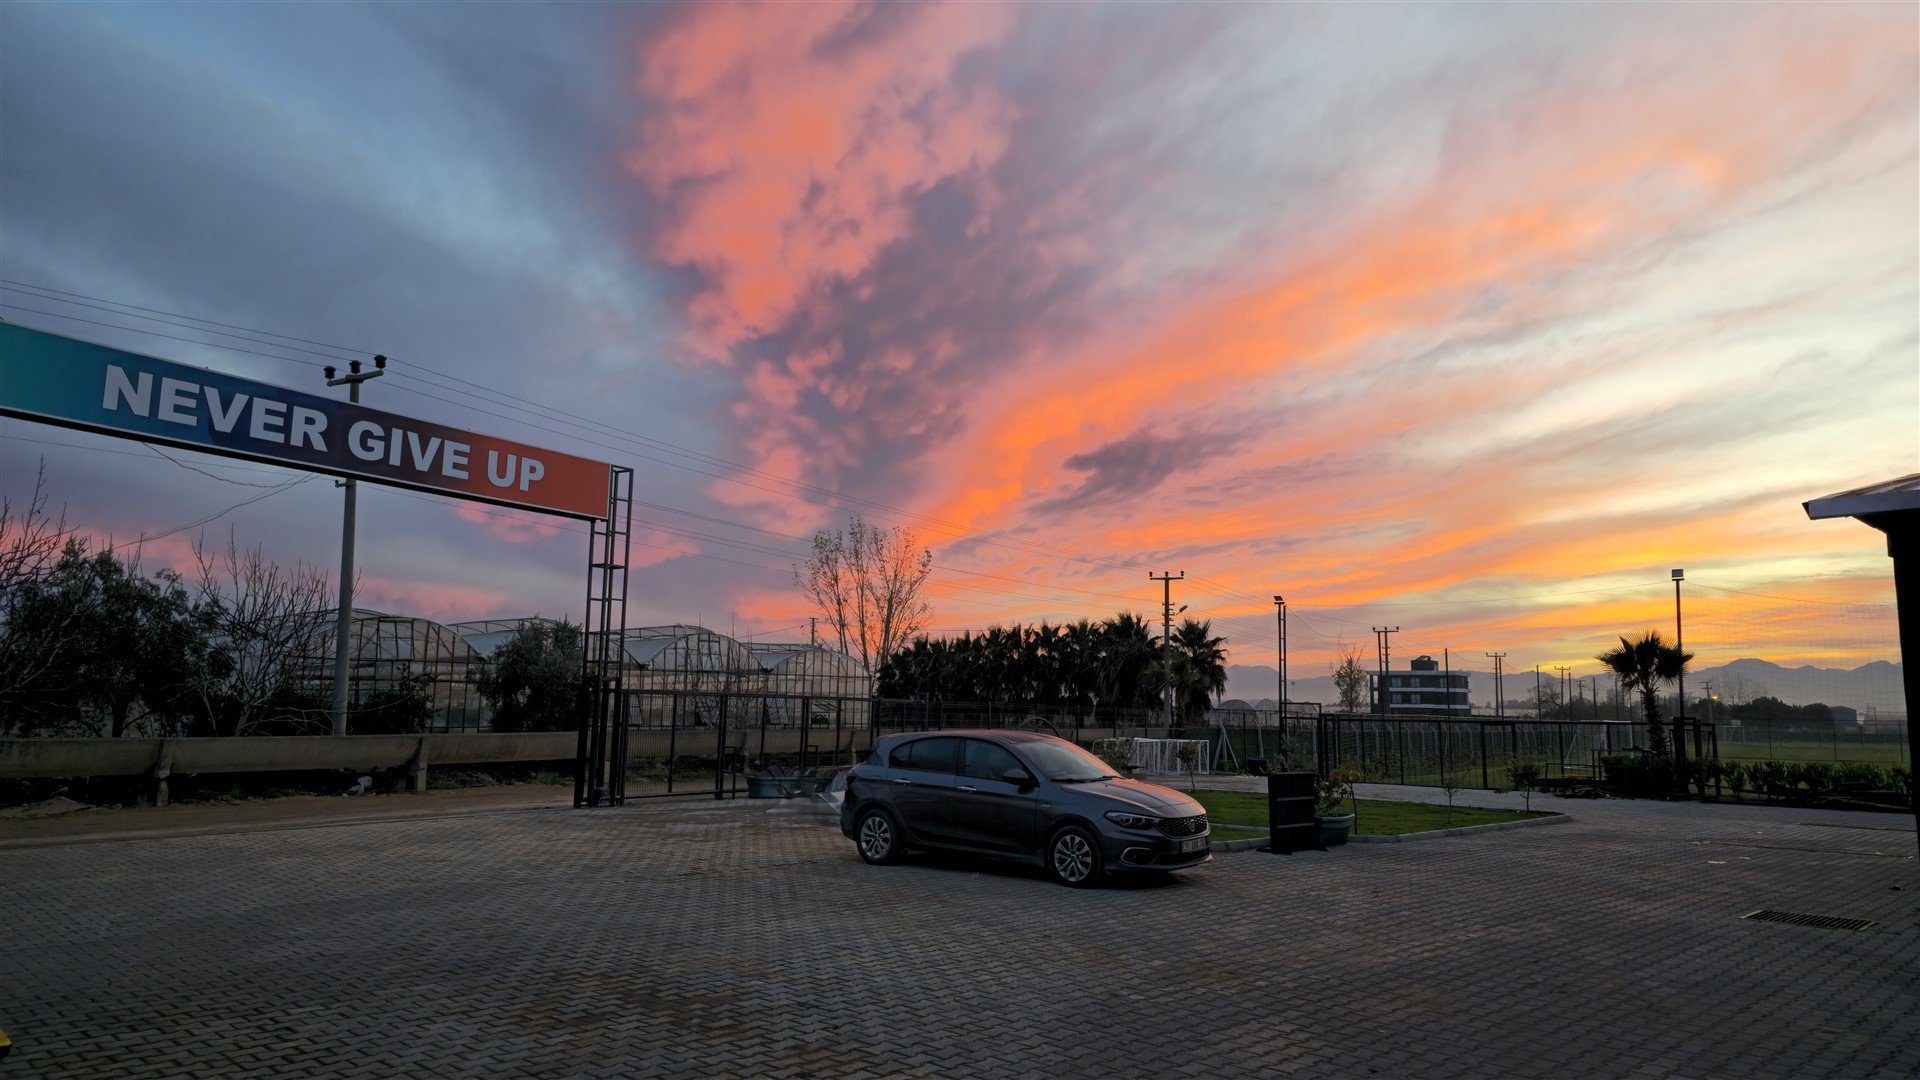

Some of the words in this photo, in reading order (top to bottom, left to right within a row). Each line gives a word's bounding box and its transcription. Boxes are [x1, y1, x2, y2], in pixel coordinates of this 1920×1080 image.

[103, 365, 328, 452] NEVER
[349, 421, 471, 480] GIVE
[487, 450, 544, 491] UP
